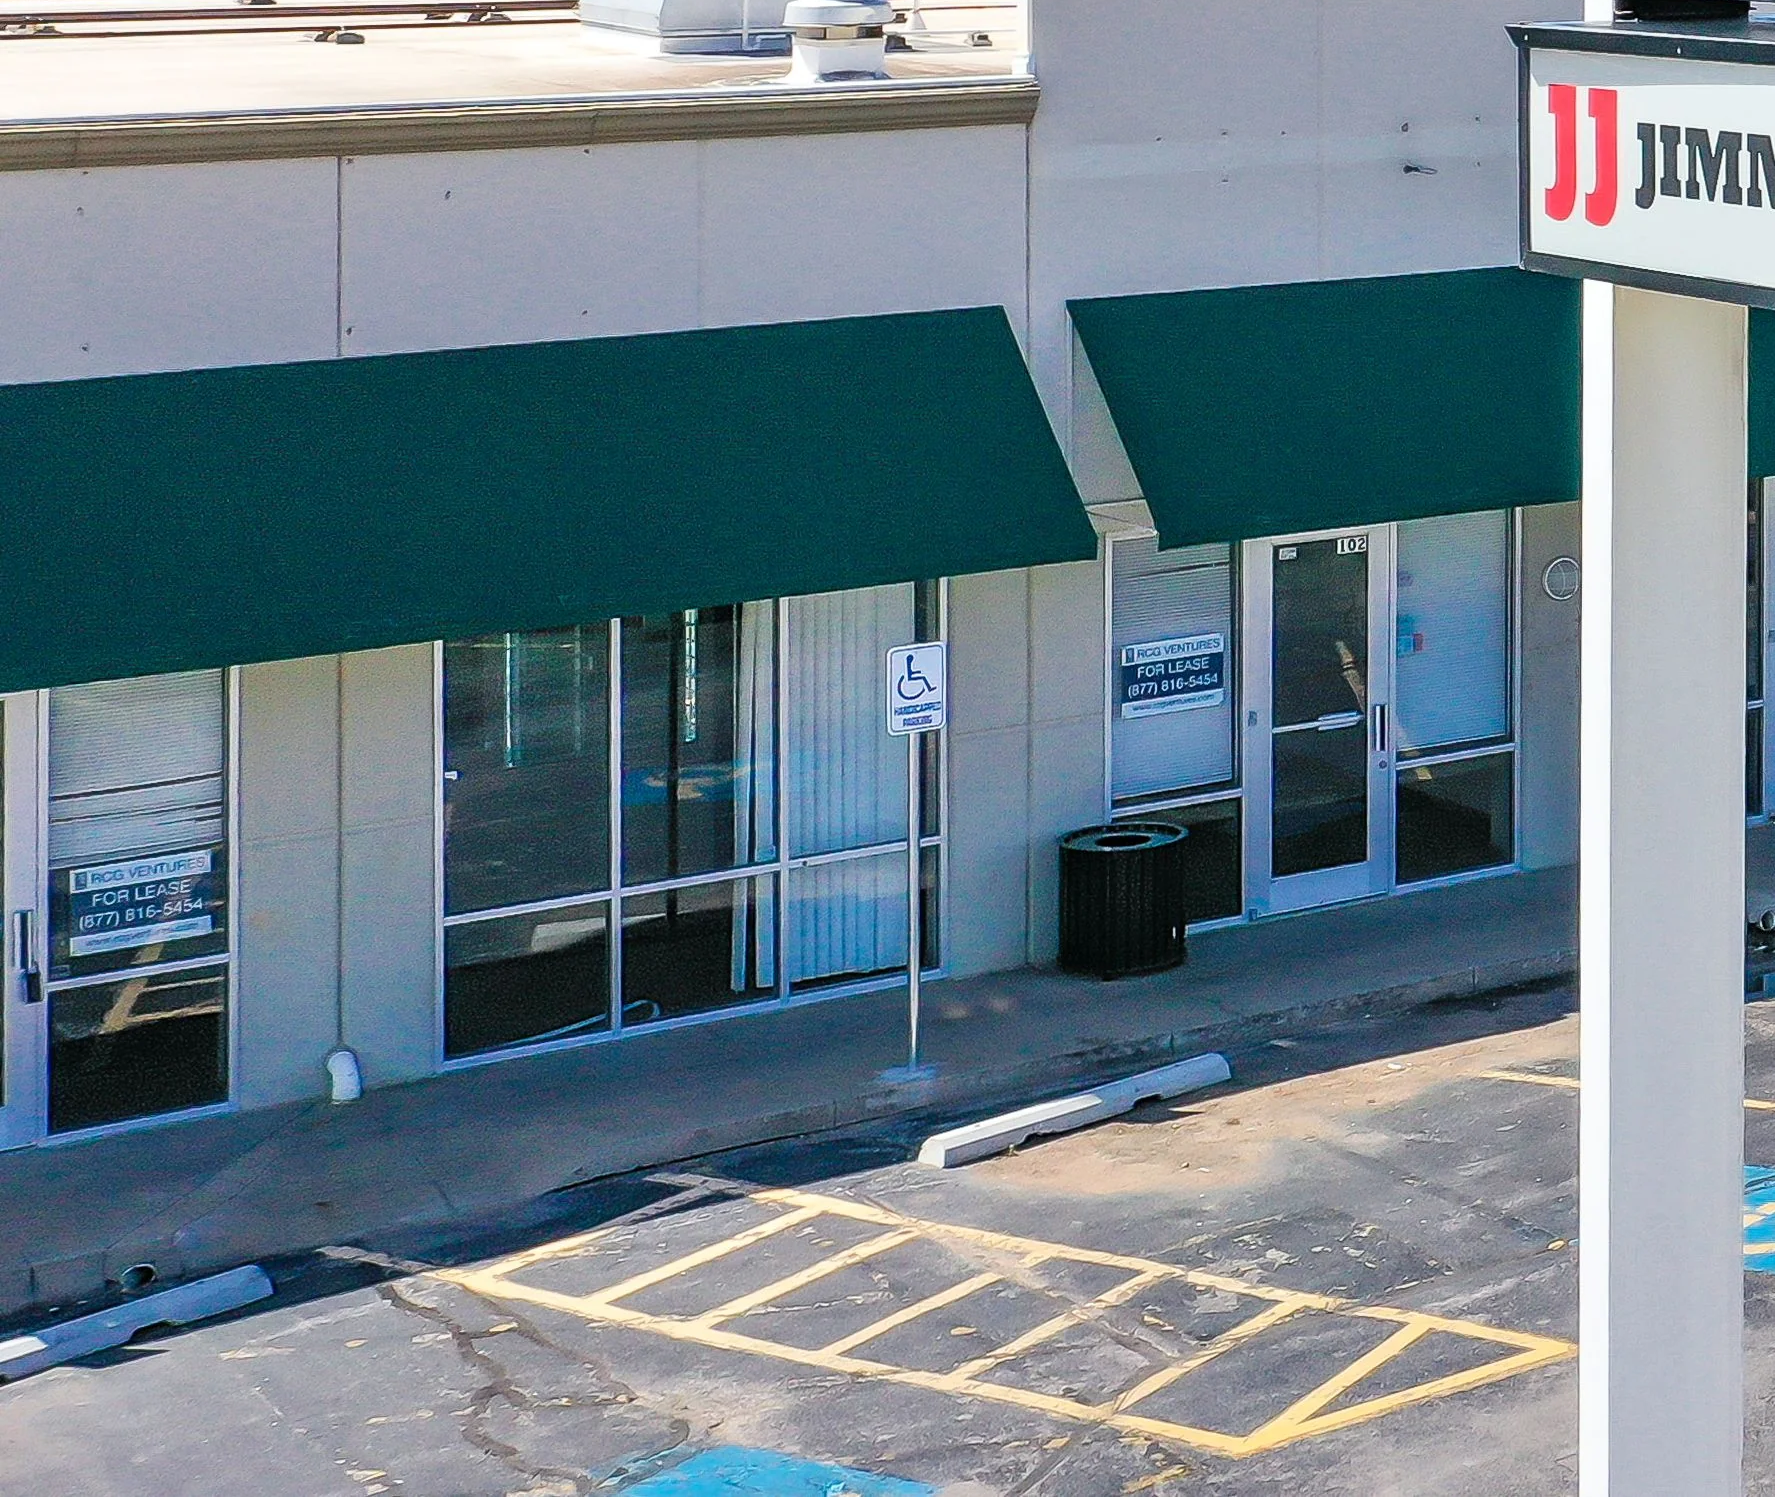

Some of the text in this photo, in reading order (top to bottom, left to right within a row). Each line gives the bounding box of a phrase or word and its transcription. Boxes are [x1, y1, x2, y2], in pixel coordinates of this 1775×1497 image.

[1545, 84, 1618, 226] JJ
[1340, 537, 1366, 552] 102
[1162, 638, 1220, 655] VENTURES
[1137, 657, 1210, 678] FOR LEASE
[1128, 673, 1218, 698] (877) 816-5454
[129, 856, 205, 879] VENTURES
[92, 879, 192, 906] FOR LEASE
[79, 898, 203, 931] (877) 816-5454
